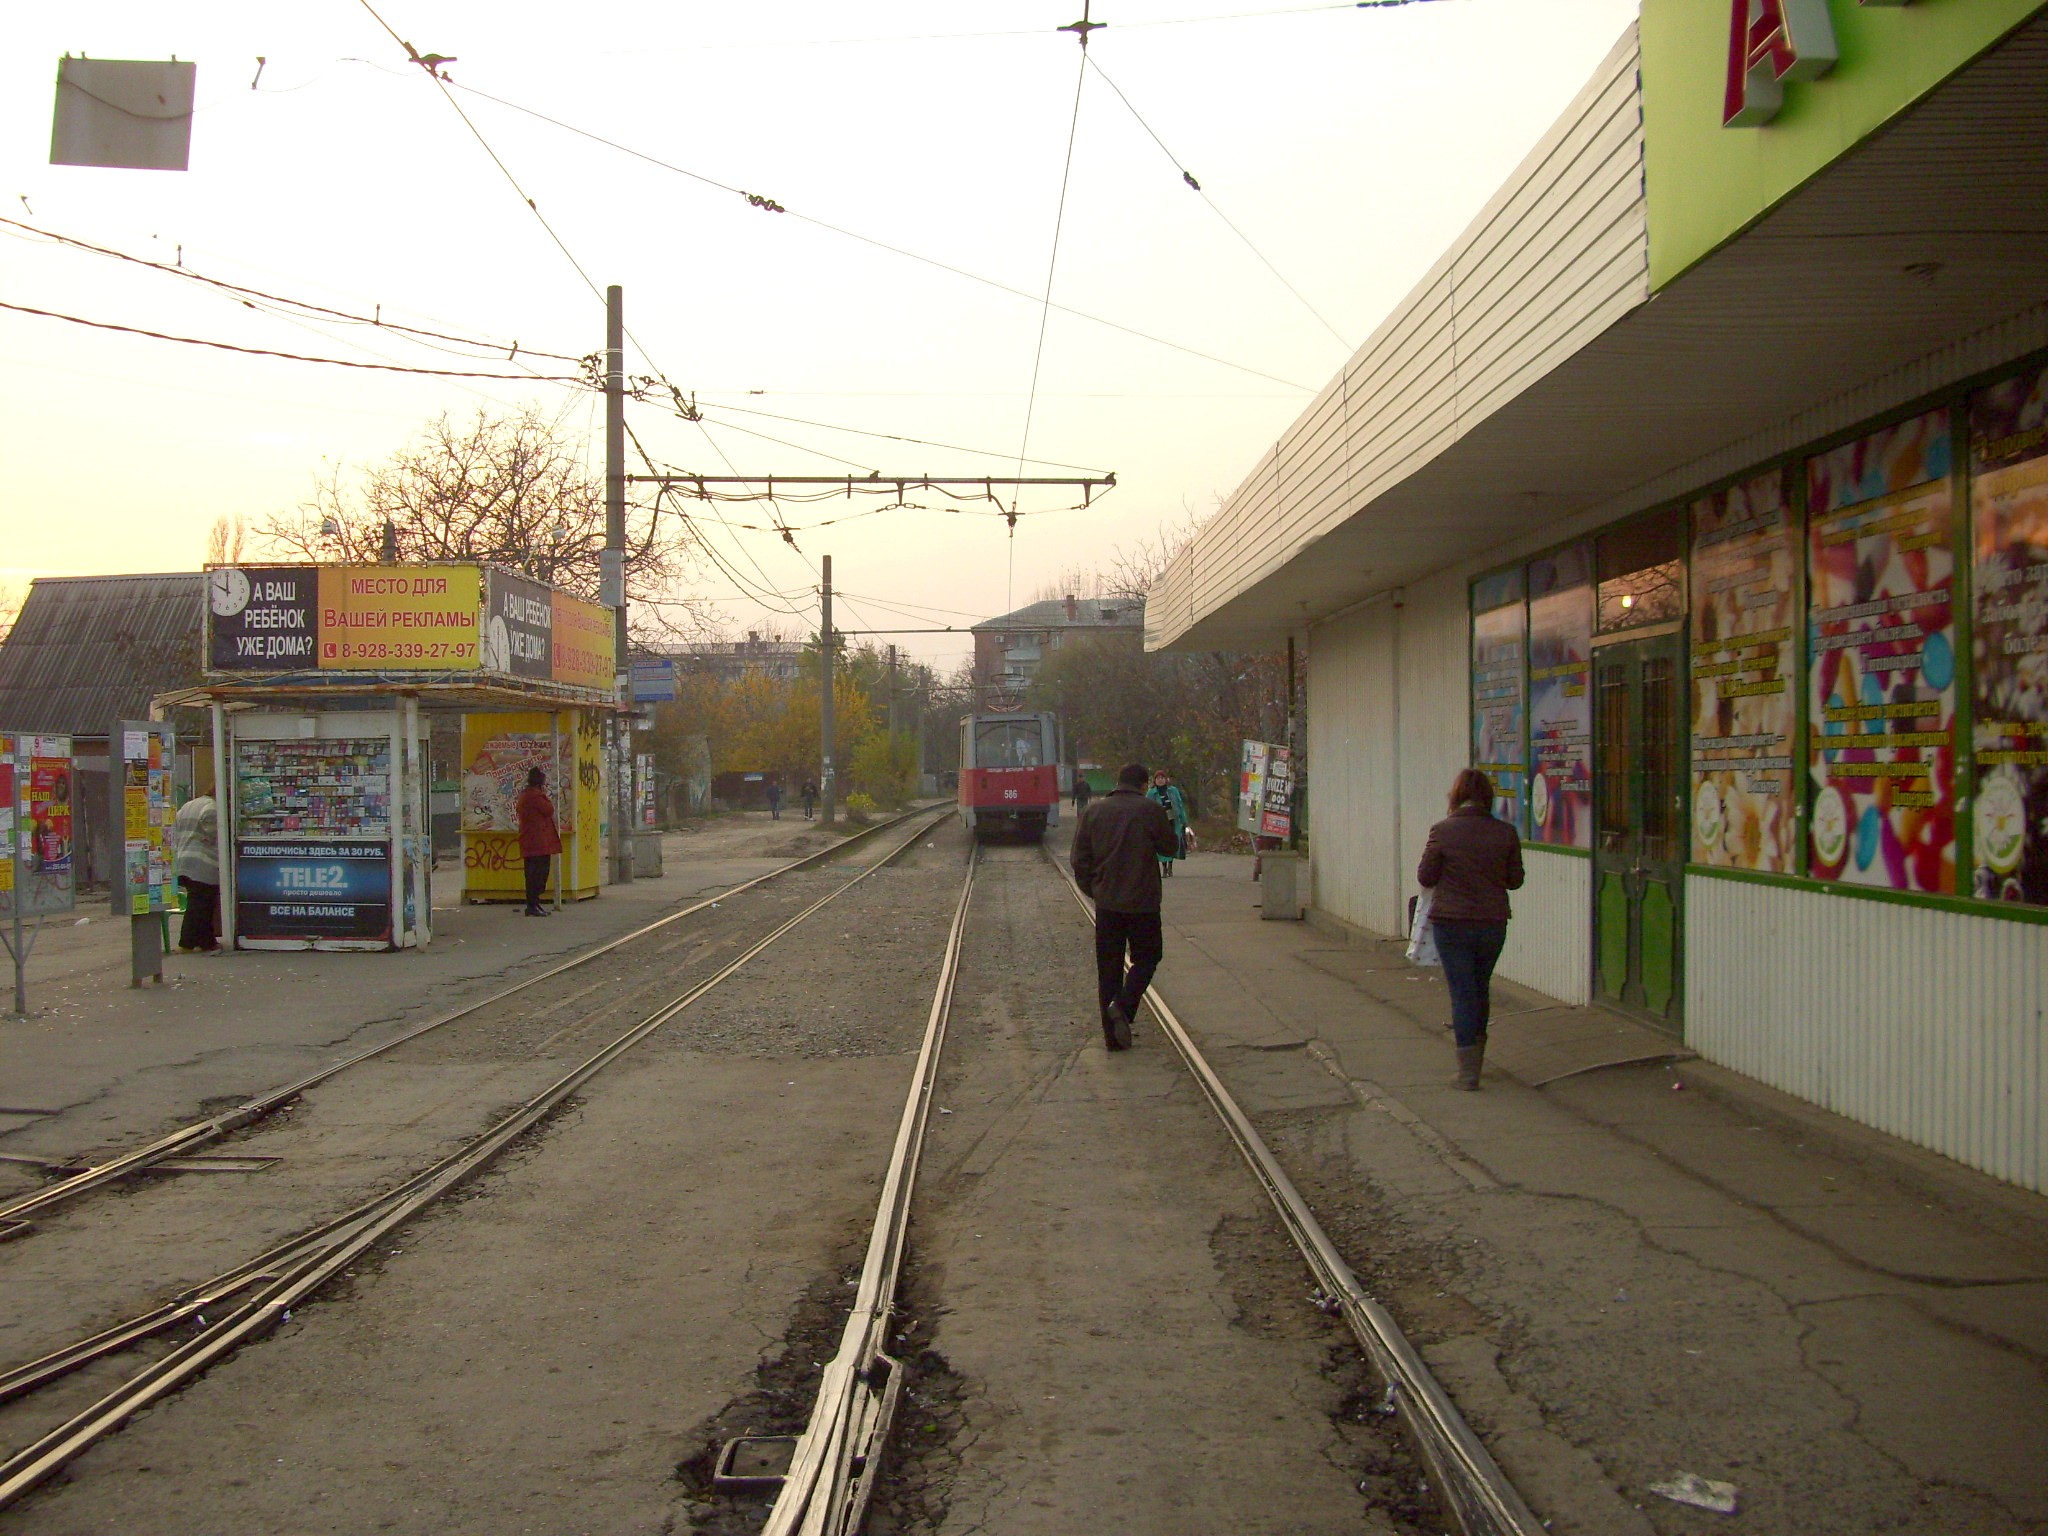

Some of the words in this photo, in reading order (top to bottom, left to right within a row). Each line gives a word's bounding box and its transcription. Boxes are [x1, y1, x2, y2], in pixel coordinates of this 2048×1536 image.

[253, 582, 263, 601] А
[265, 582, 296, 601] ВАШ
[351, 578, 408, 595] МЕСТО
[412, 578, 447, 597] ДЛЯ
[244, 605, 305, 629] РЕБЁНОК
[324, 608, 387, 628] ВАШЕЙ
[392, 611, 476, 628] РЕКЛАМЫ
[503, 591, 509, 617] А
[509, 593, 525, 622] ВАШ
[526, 597, 552, 629] РЕБЁНОК
[236, 637, 264, 656] УЖЕ
[266, 636, 313, 660] ДОМА?
[342, 642, 476, 659] 8-928-339-27-97
[510, 629, 525, 657] УЖЕ
[525, 633, 546, 663] ДОМА?
[31, 790, 50, 802] НАШ
[1004, 789, 1018, 799] 586
[47, 805, 71, 817] ЦИРК
[309, 847, 337, 856] ЗДЕСЬ
[338, 848, 350, 856] ЗА
[351, 848, 363, 857] 30
[364, 848, 384, 857] РУБ.
[283, 889, 308, 897] просто
[270, 906, 290, 915] ВСЕ
[292, 906, 306, 916] НА
[308, 906, 355, 917] БАЛАНСЕ
